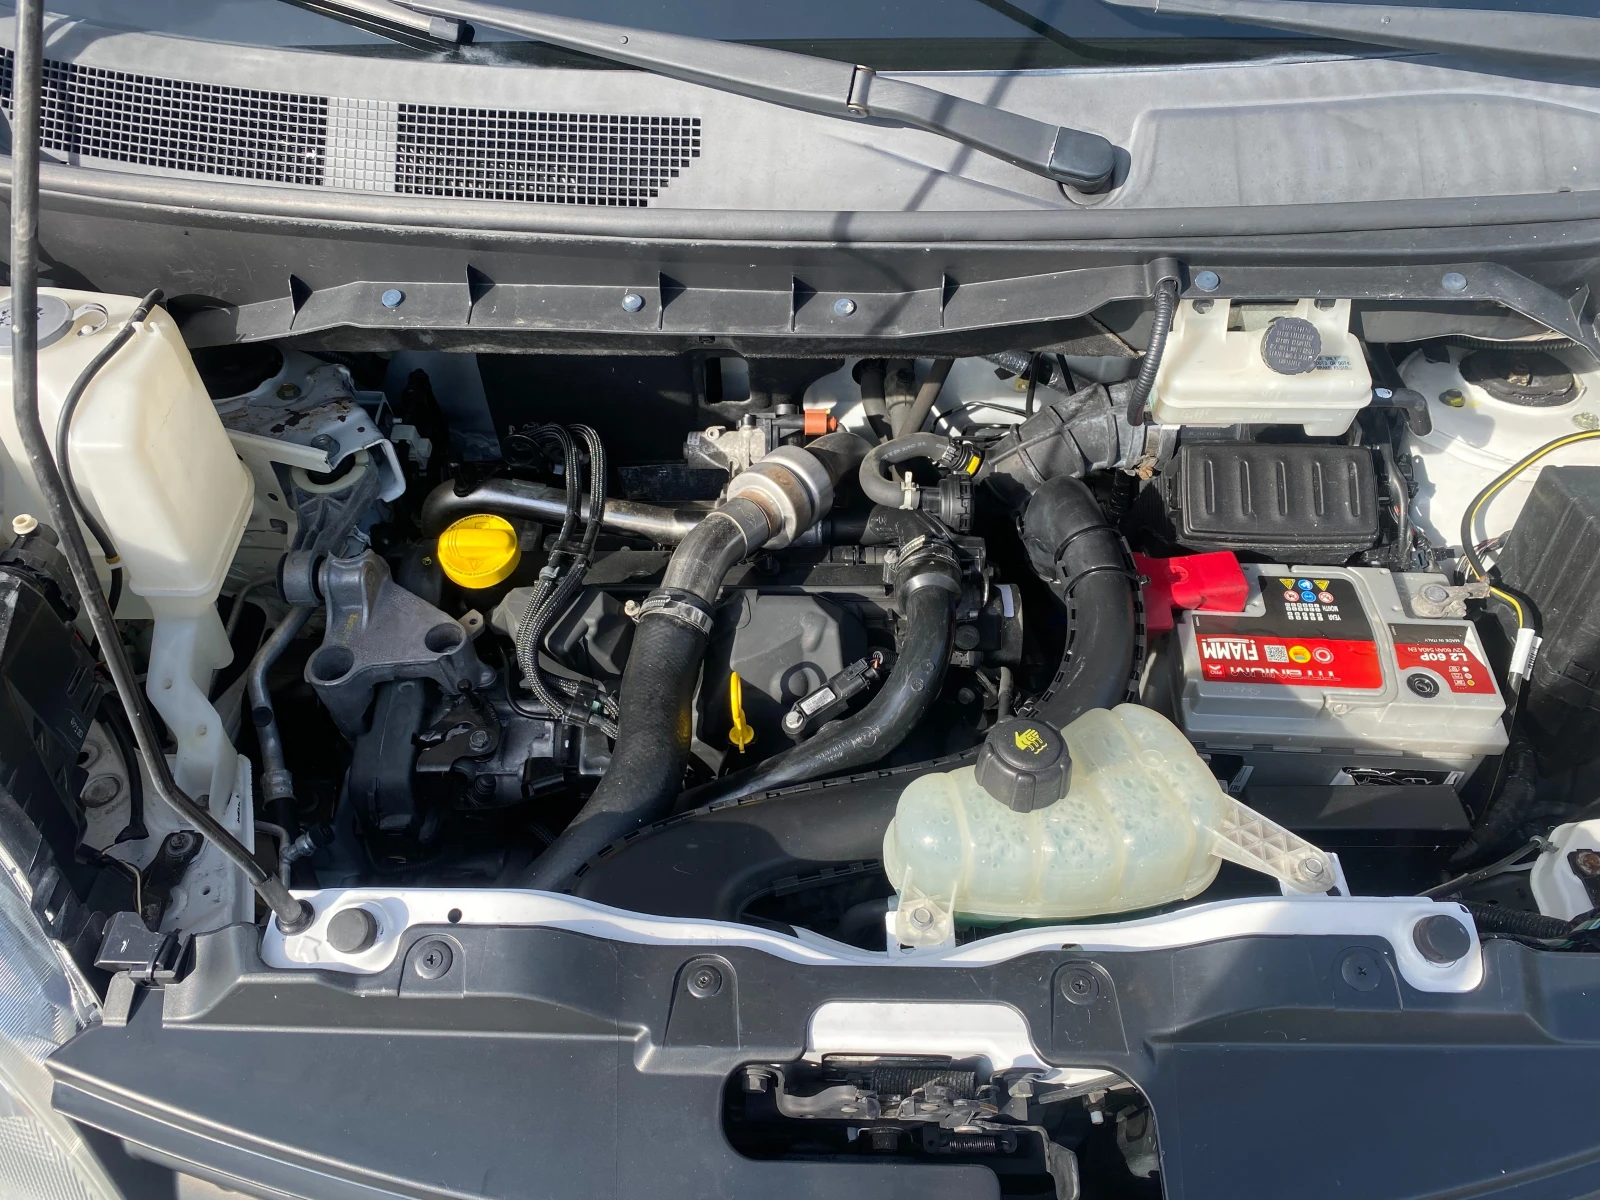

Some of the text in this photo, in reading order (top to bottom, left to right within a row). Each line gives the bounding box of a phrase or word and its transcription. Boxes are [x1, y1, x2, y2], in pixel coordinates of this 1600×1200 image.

[1327, 613, 1342, 621] YEAR
[1202, 642, 1259, 660] FIAMM
[1420, 653, 1468, 661] L2 60P
[1229, 666, 1341, 681] TITANIUM
